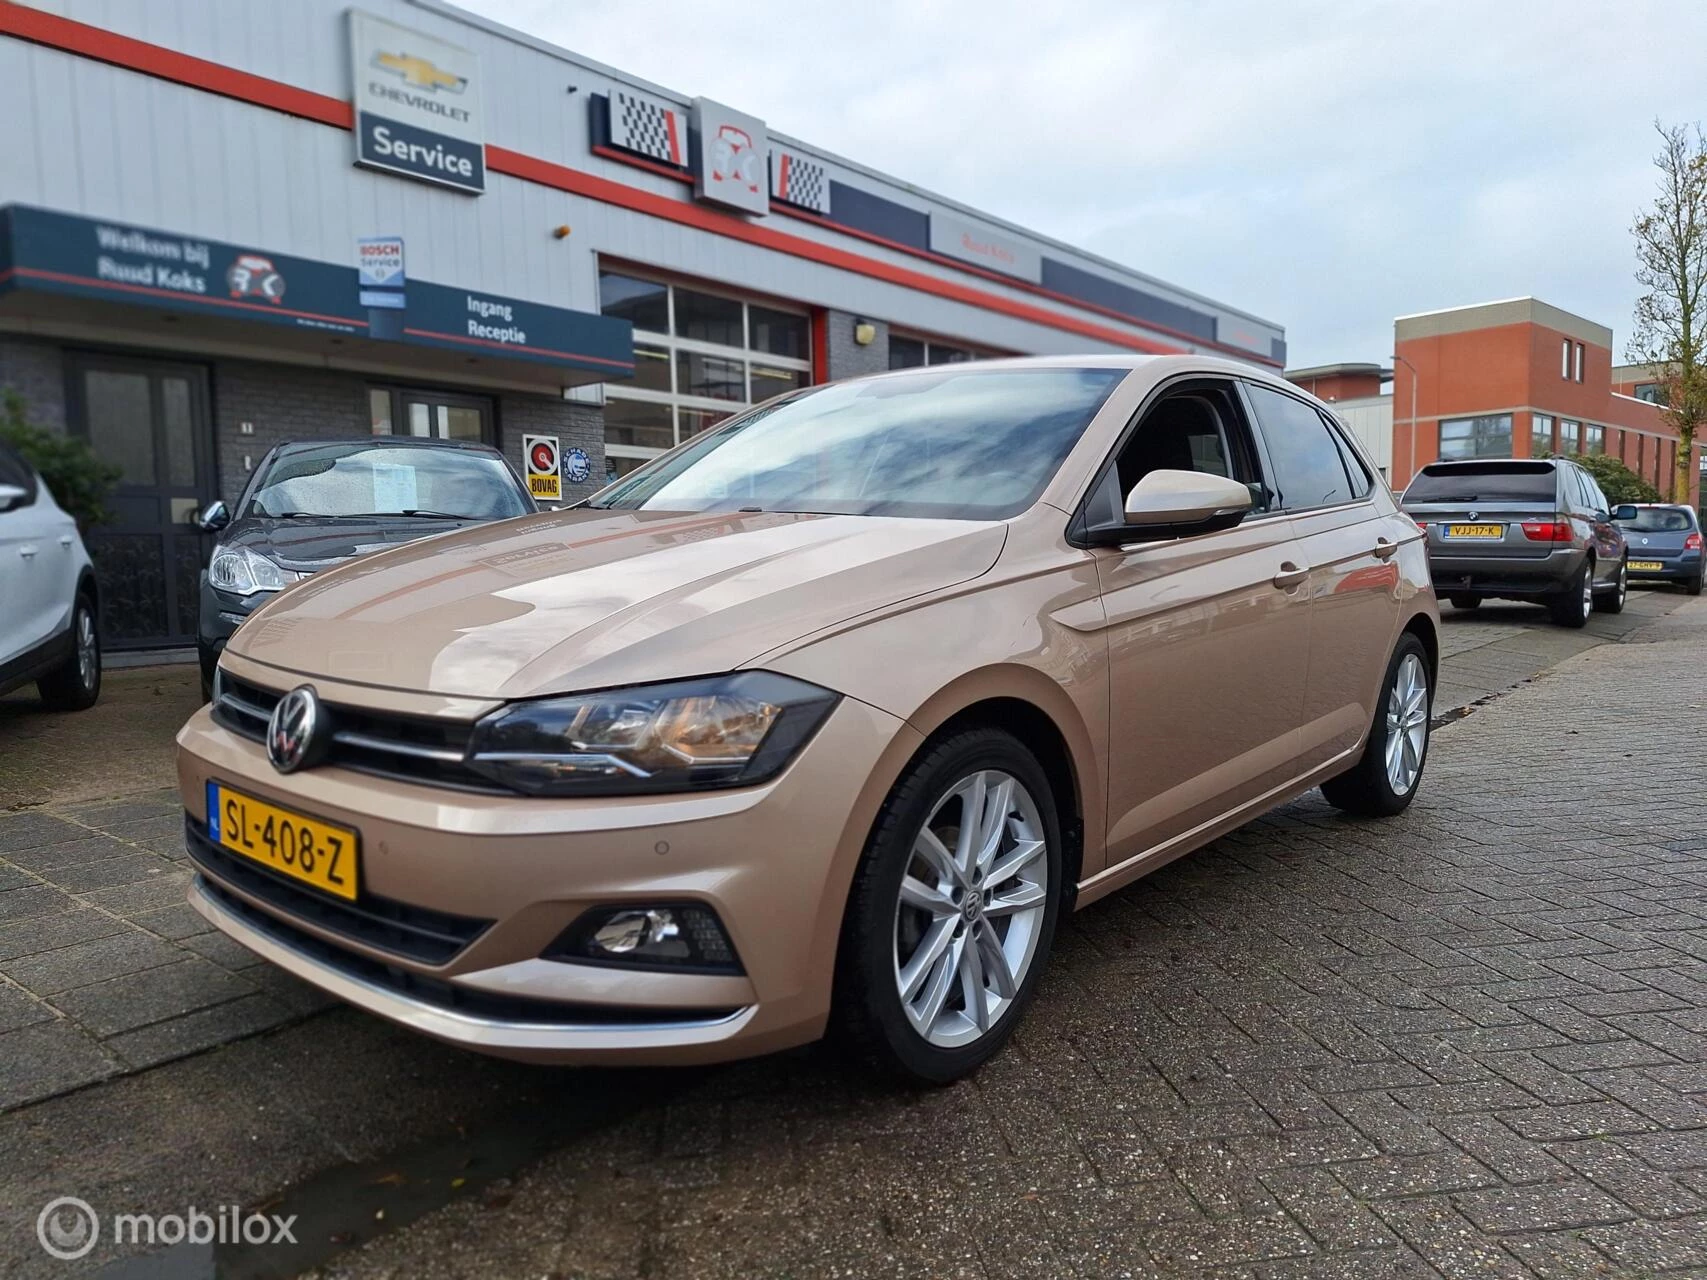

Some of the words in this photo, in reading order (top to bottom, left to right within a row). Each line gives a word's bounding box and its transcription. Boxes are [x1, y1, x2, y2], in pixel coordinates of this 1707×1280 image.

[368, 82, 470, 123] CHEVROLET
[373, 126, 473, 176] Service
[97, 225, 181, 259] Welkom
[183, 242, 209, 270] bij
[360, 245, 400, 256] BOSCH
[98, 256, 154, 284] Ruud
[156, 266, 206, 293] Koks
[360, 257, 400, 268] Service
[467, 295, 512, 321] Ingang
[467, 320, 527, 344] Receptie
[532, 478, 558, 493] BOVAG
[1455, 526, 1495, 535] VJJ-17-K
[226, 799, 345, 886] SL-408-Z
